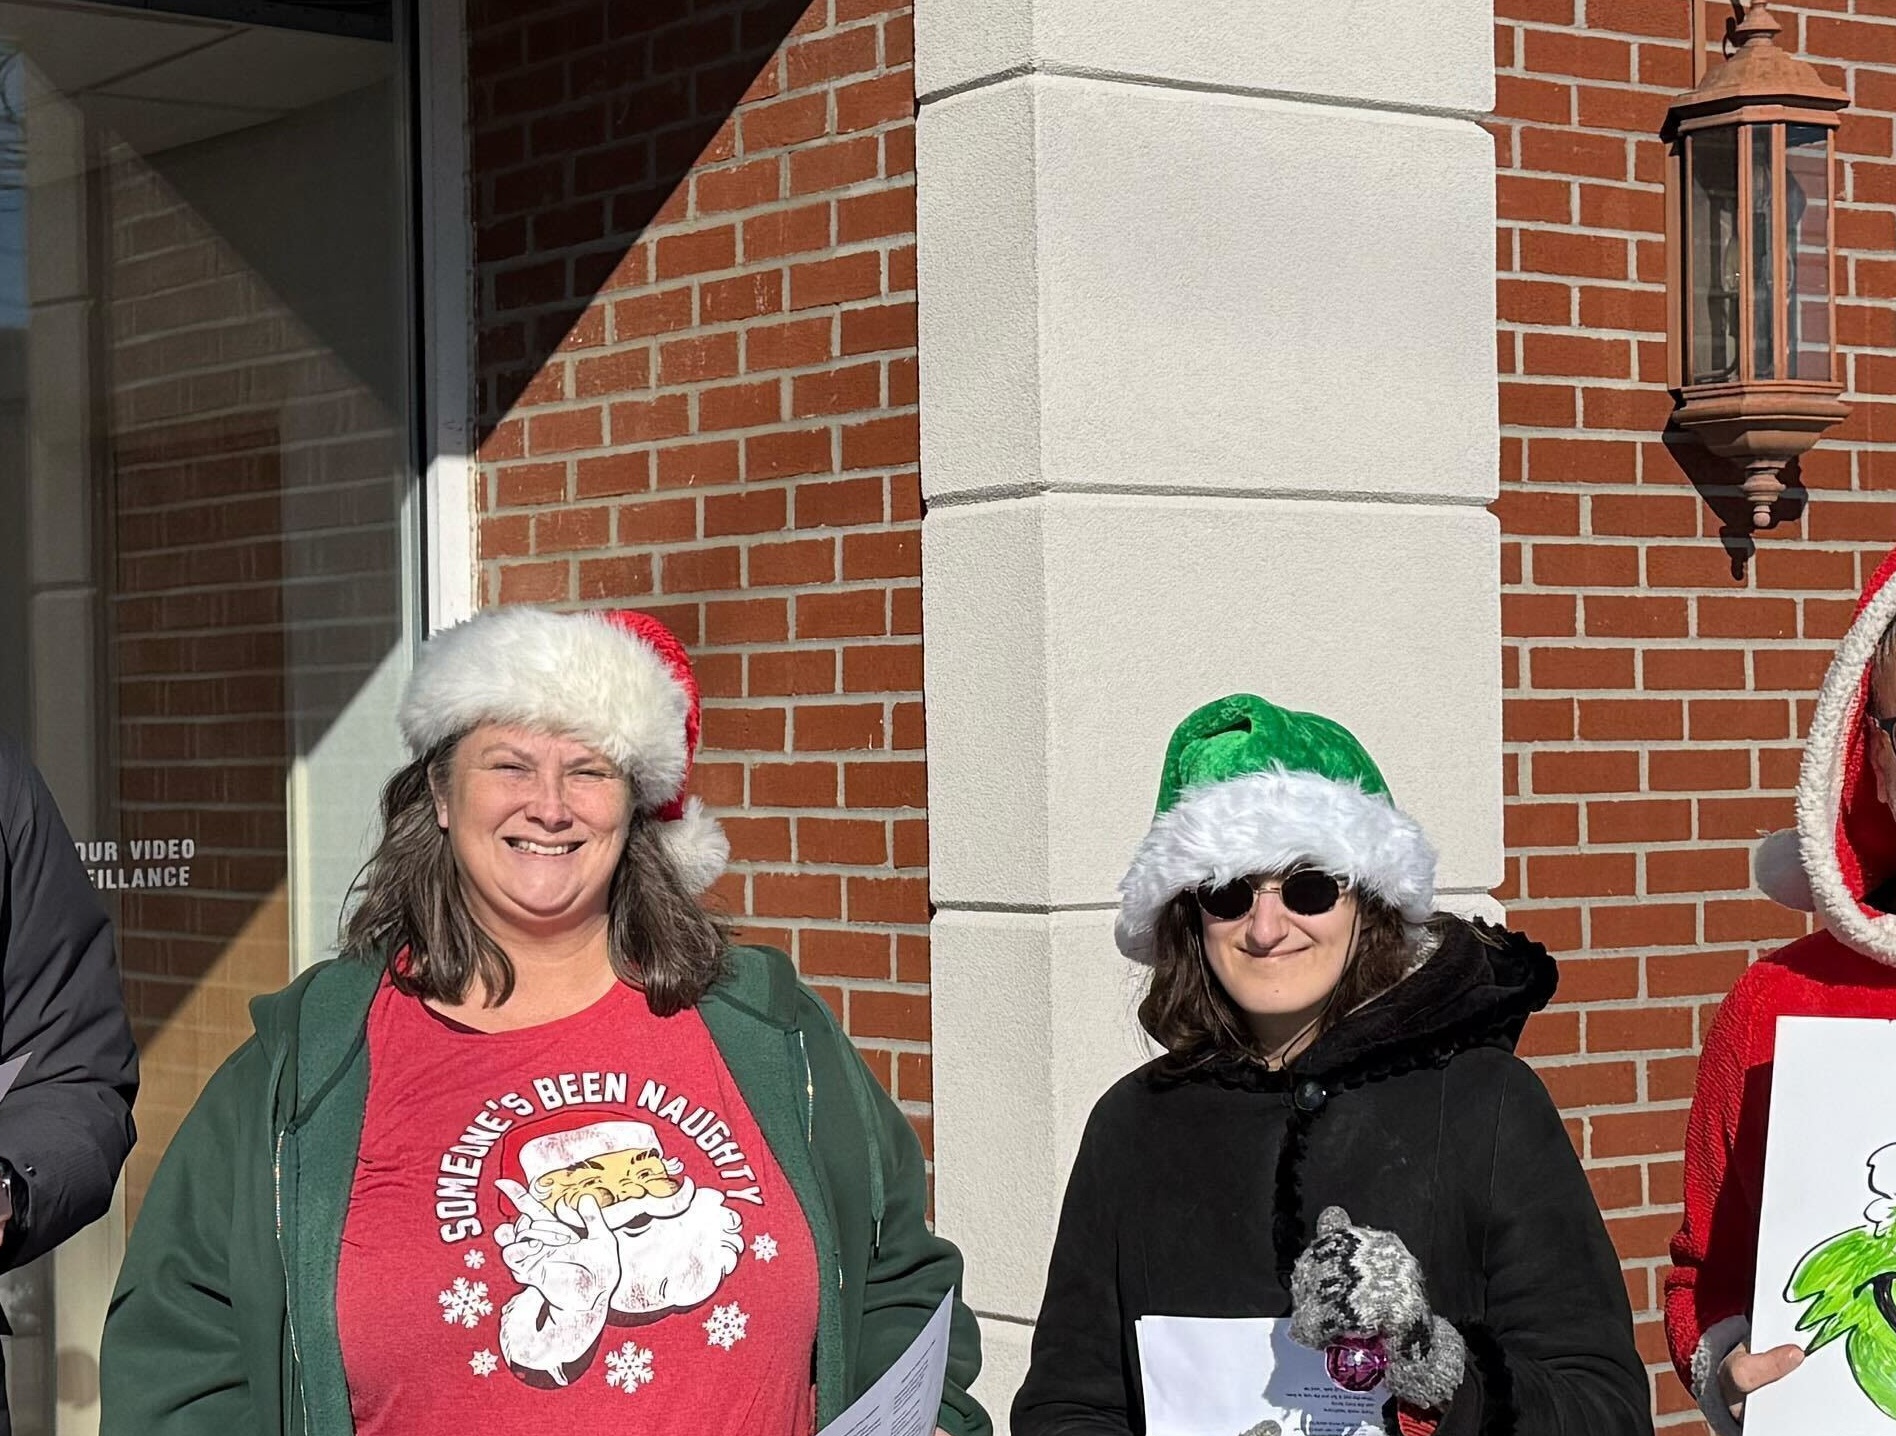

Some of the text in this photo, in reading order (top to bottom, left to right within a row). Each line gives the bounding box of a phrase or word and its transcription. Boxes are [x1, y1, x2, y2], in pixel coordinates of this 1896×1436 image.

[130, 839, 195, 861] VIDEO
[434, 1071, 766, 1244] SOMEONE'S BEEN NAUGHTY
